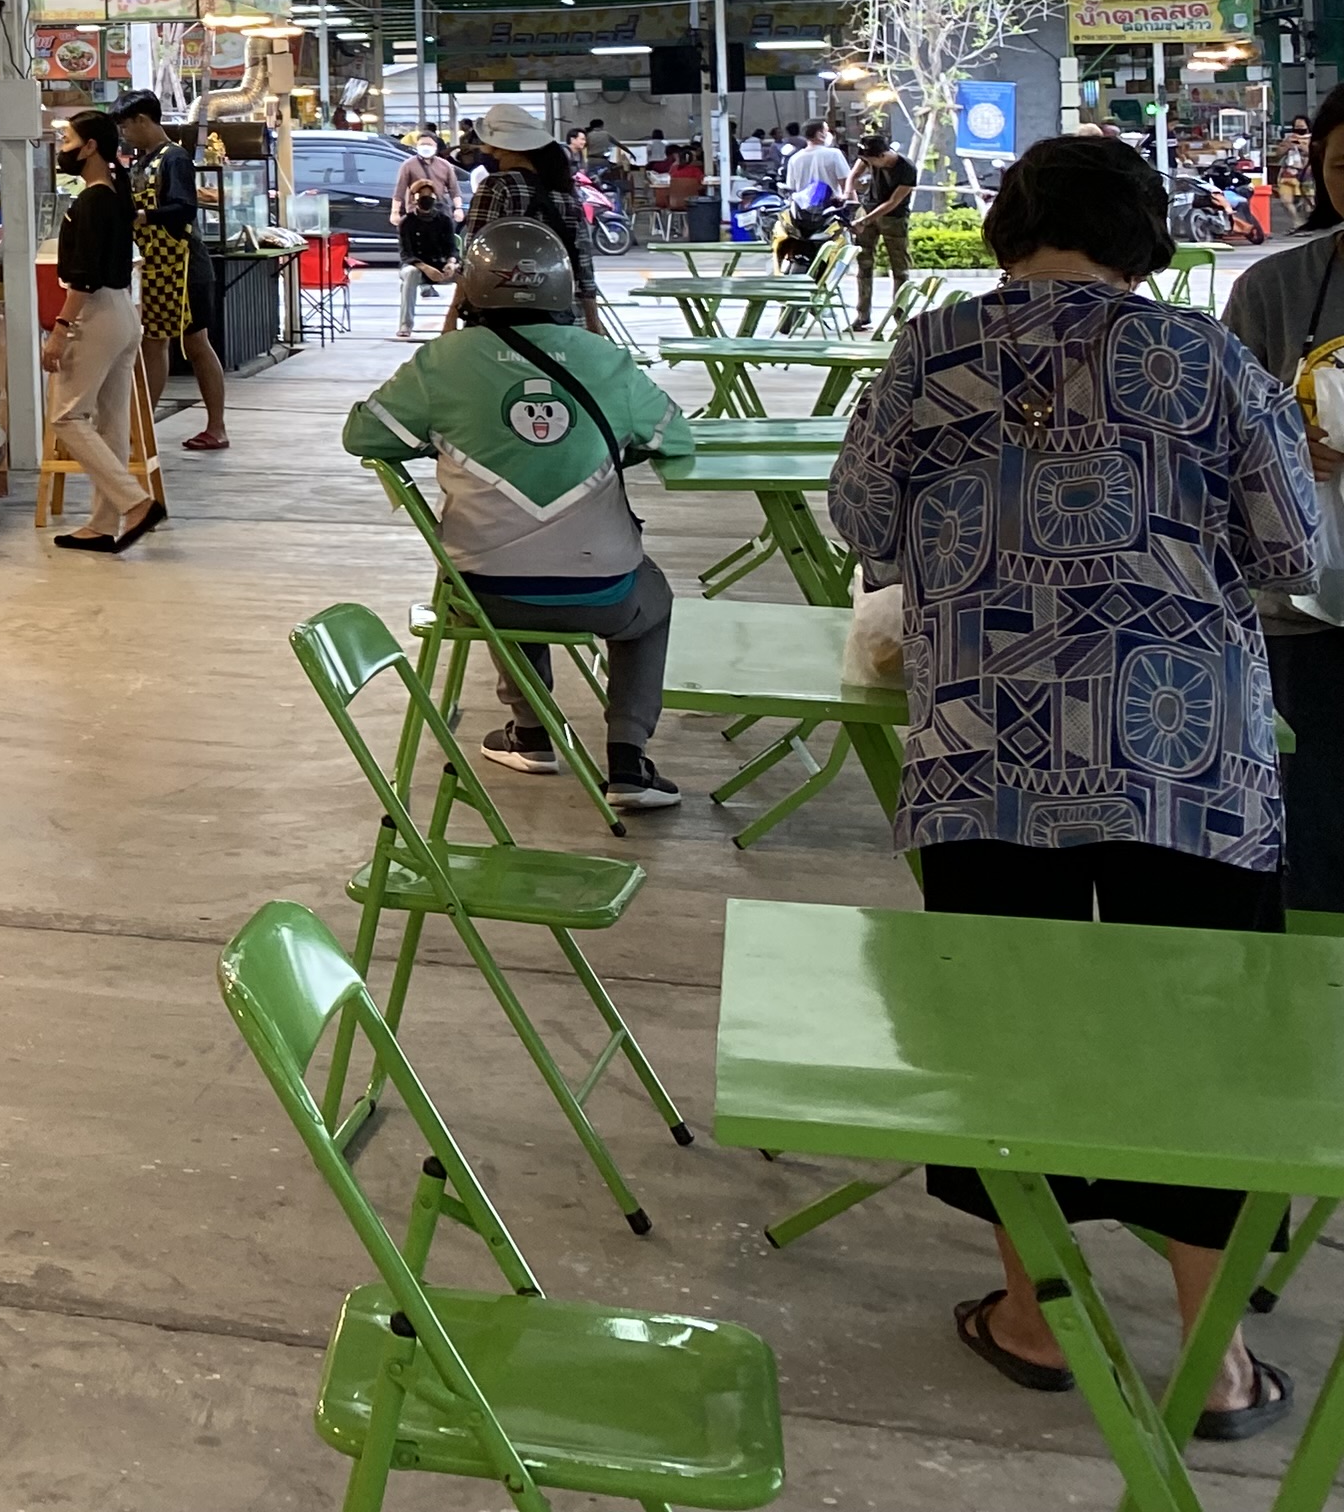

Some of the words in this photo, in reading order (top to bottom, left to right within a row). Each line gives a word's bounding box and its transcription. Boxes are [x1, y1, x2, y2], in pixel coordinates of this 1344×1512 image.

[1075, 0, 1211, 27] น้ำตาลสด
[497, 350, 567, 363] LINAN
